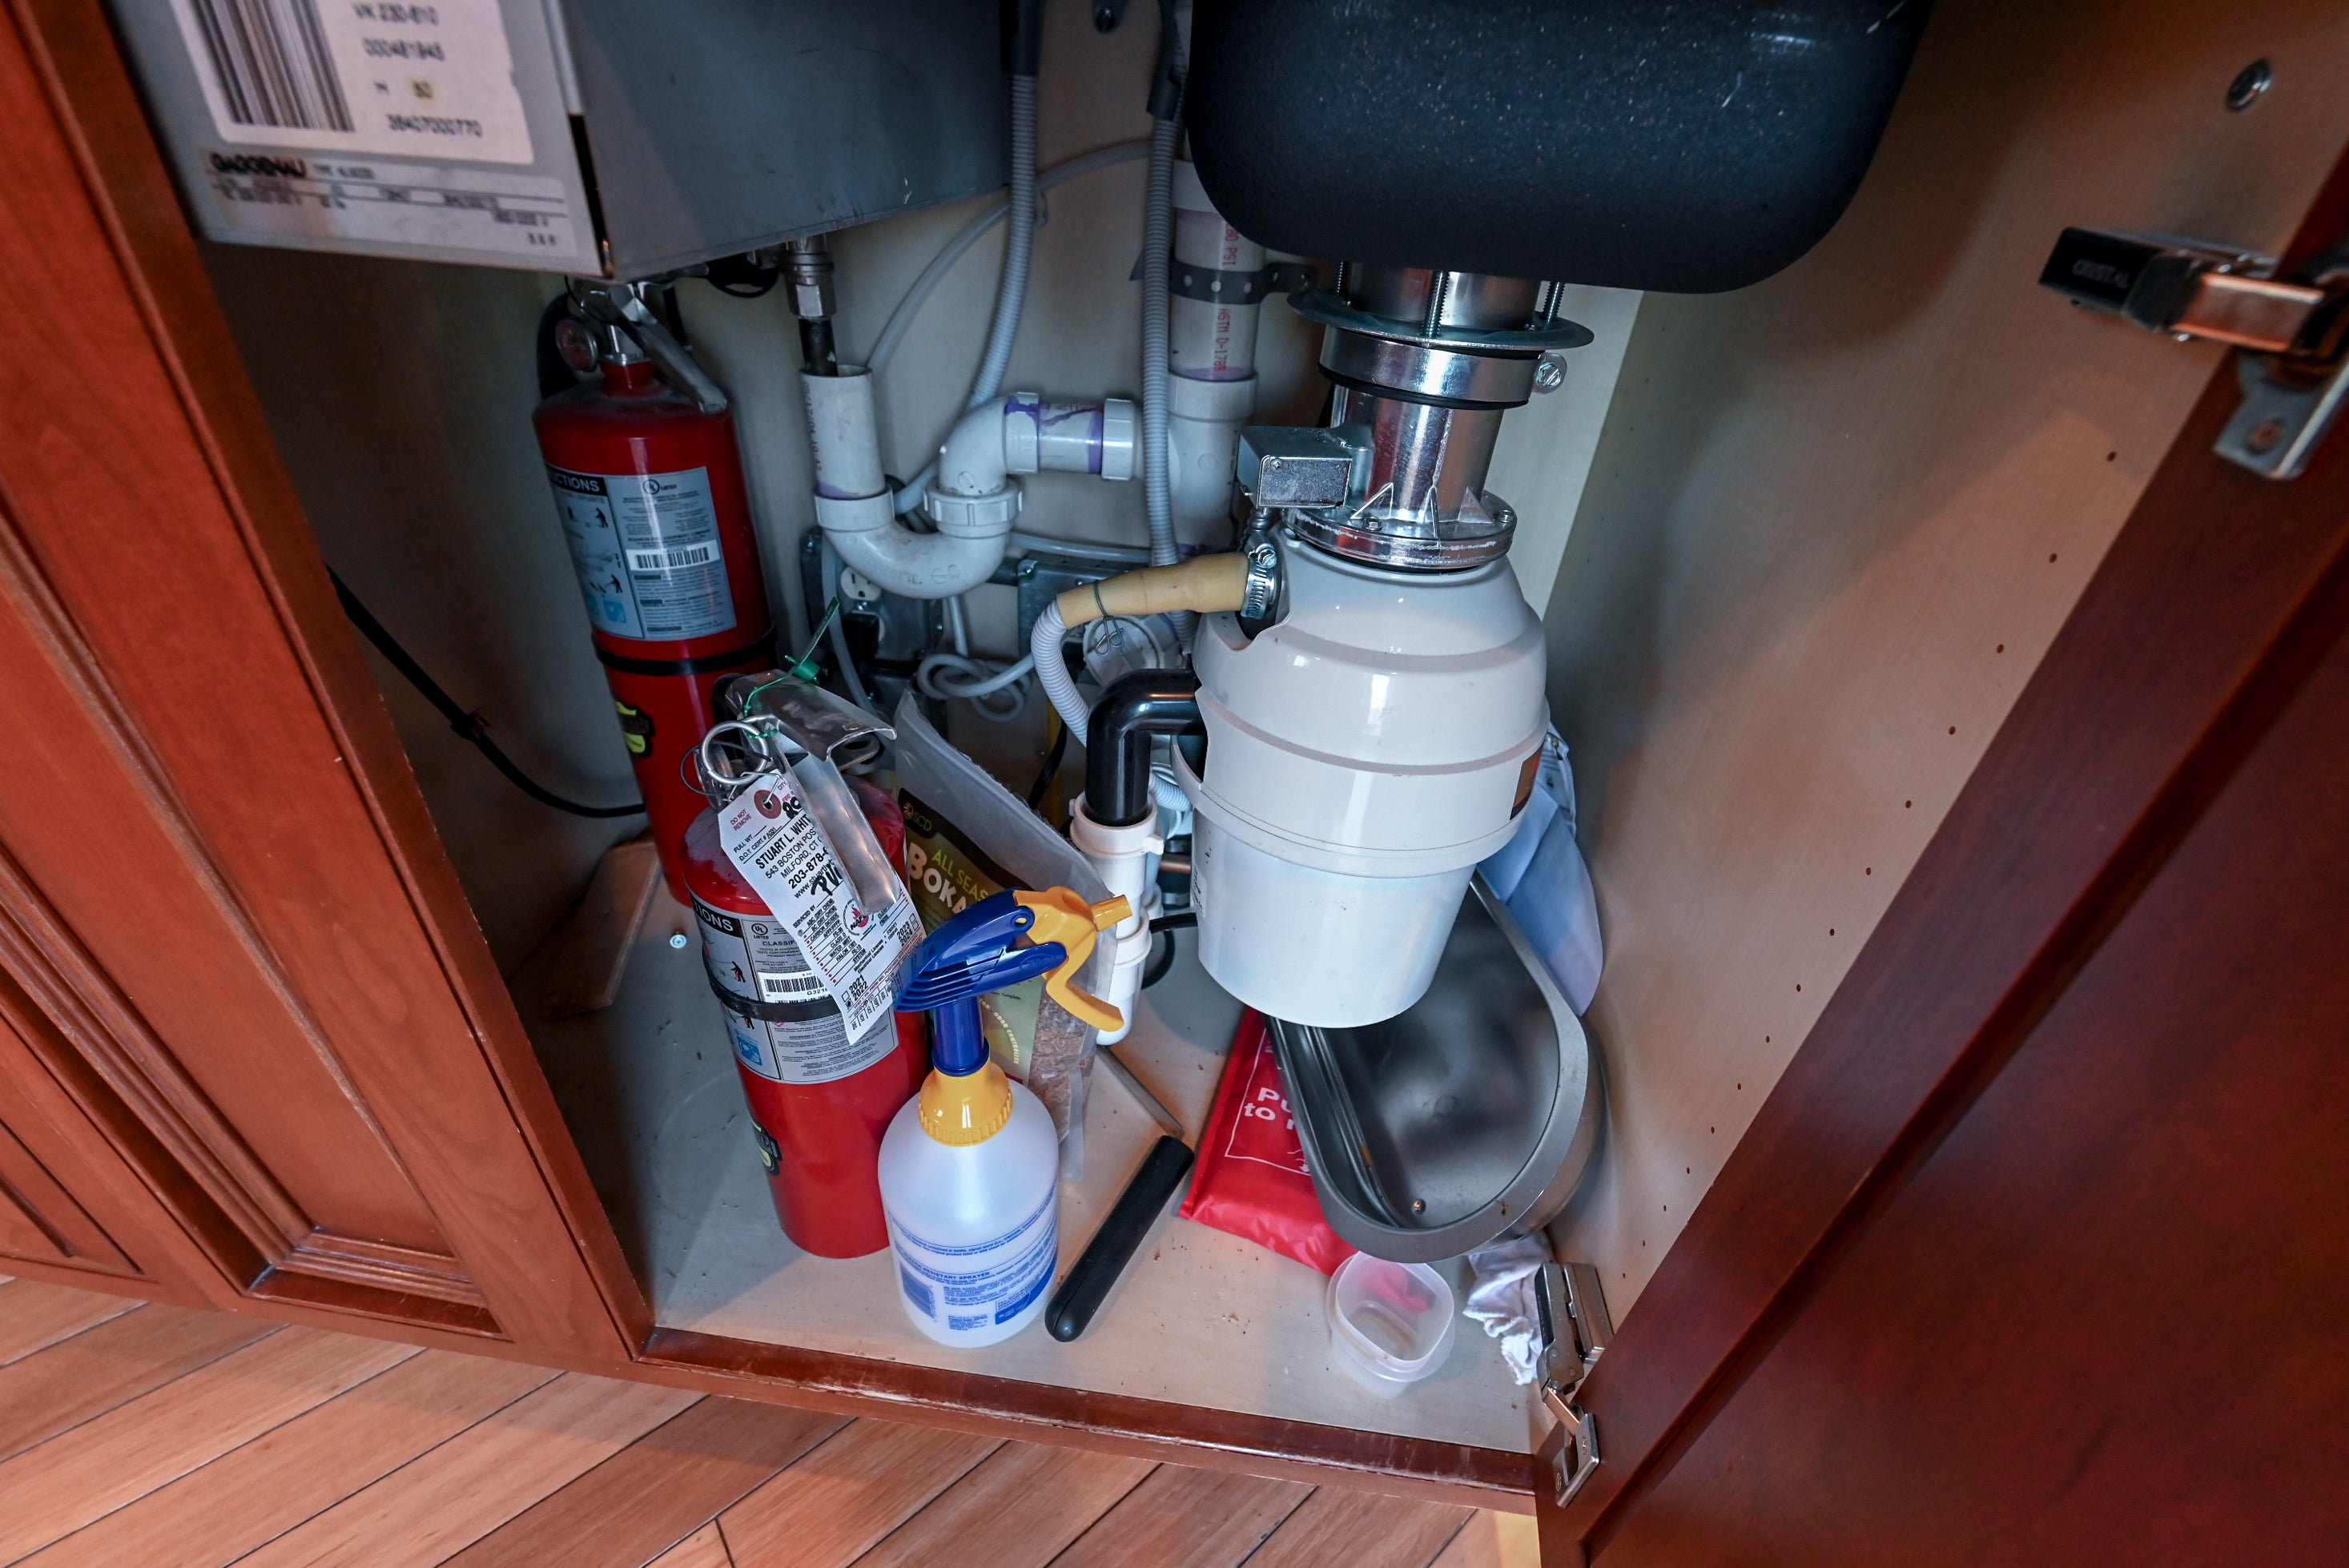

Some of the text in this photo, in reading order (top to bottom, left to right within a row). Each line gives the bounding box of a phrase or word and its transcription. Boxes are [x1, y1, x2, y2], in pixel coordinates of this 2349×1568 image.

[1222, 247, 1237, 266] PSI
[1217, 308, 1231, 332] ASTM
[730, 809, 746, 825] DO NOT
[733, 814, 751, 830] REMOVE
[913, 812, 931, 831] SCD
[734, 841, 746, 852] FULL
[755, 838, 787, 869] STUART
[784, 831, 794, 842] L.
[766, 865, 779, 878] 543
[778, 841, 804, 866] BOSTON
[781, 840, 819, 878] MILFORD, CT
[931, 849, 954, 877] ALL
[793, 910, 811, 927] SERVICED
[806, 917, 815, 925] ABC
[815, 909, 823, 919] (DRY
[809, 912, 839, 941] CARBON DIOXIDE
[896, 922, 911, 938] 2023
[830, 935, 843, 947] CLASS
[899, 929, 913, 945] 2024
[829, 936, 851, 957] WATER MIST
[835, 948, 848, 961] HALON
[853, 951, 871, 971] Mechanical
[871, 939, 883, 952] License
[852, 949, 866, 963] SYSTEM
[857, 944, 884, 973] Electrical License
[848, 975, 864, 993] 2021
[852, 982, 869, 1000] 2022
[993, 1011, 1008, 1027] ODOR
[1245, 1103, 1277, 1120] to
